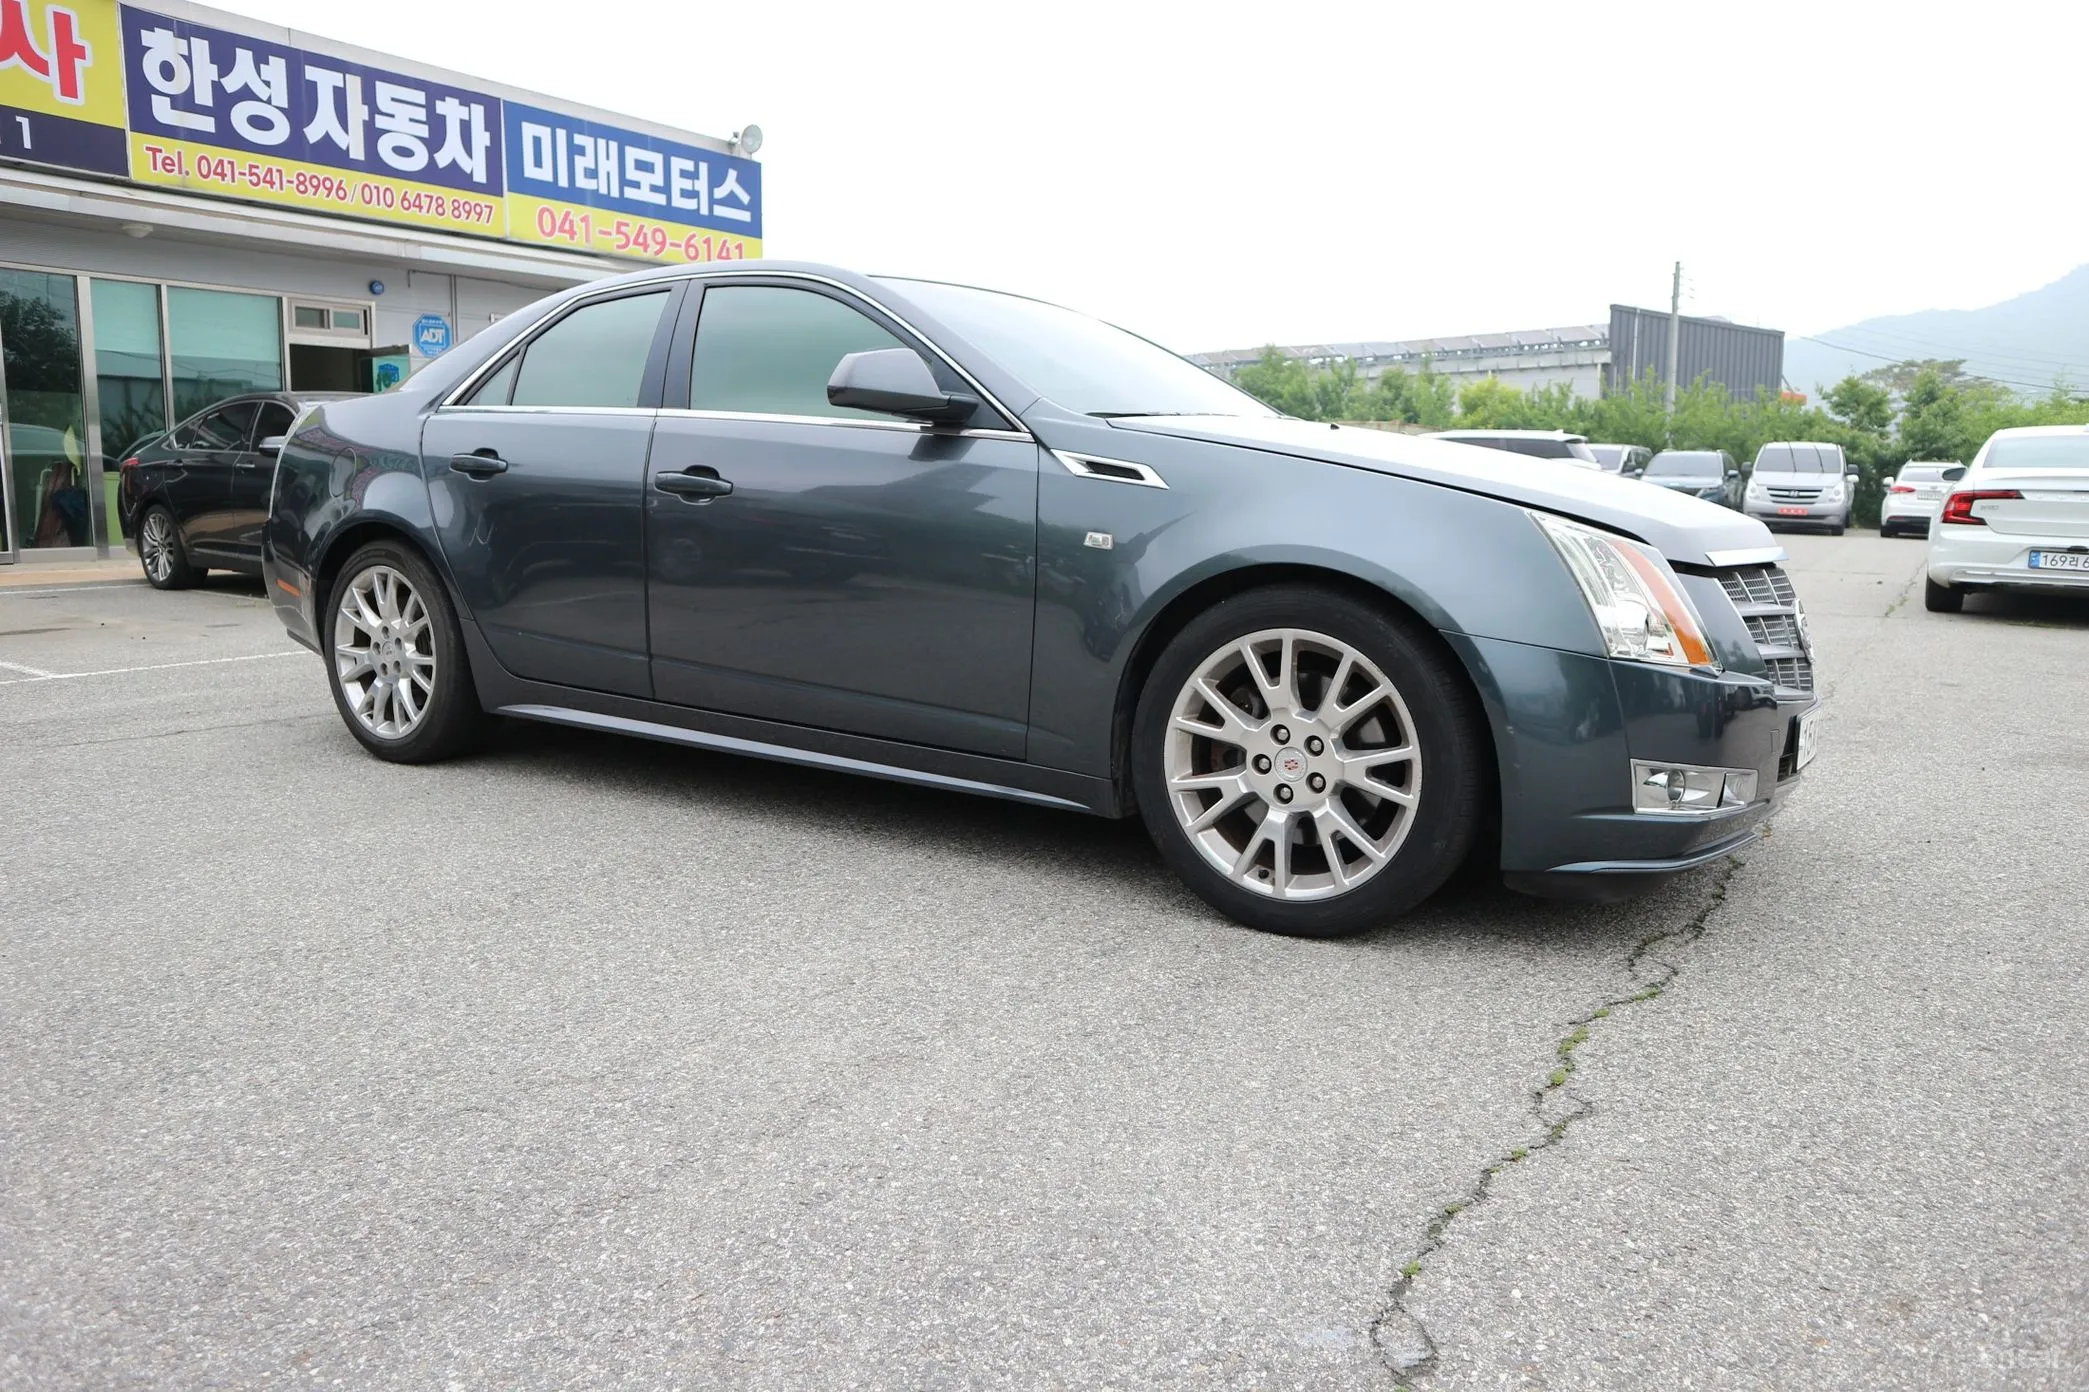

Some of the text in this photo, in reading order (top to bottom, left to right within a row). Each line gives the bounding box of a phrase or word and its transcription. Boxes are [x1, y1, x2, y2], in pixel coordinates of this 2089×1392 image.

[140, 27, 491, 184] 한성 자동차
[145, 146, 190, 177] Tel.
[197, 155, 347, 202] 041-541-8996
[361, 183, 394, 209] 010
[400, 190, 446, 218] 6478
[451, 198, 493, 225] 8997
[521, 121, 751, 223] 미래모터스
[536, 206, 744, 262] 041-549-6141
[420, 328, 446, 344] ADT
